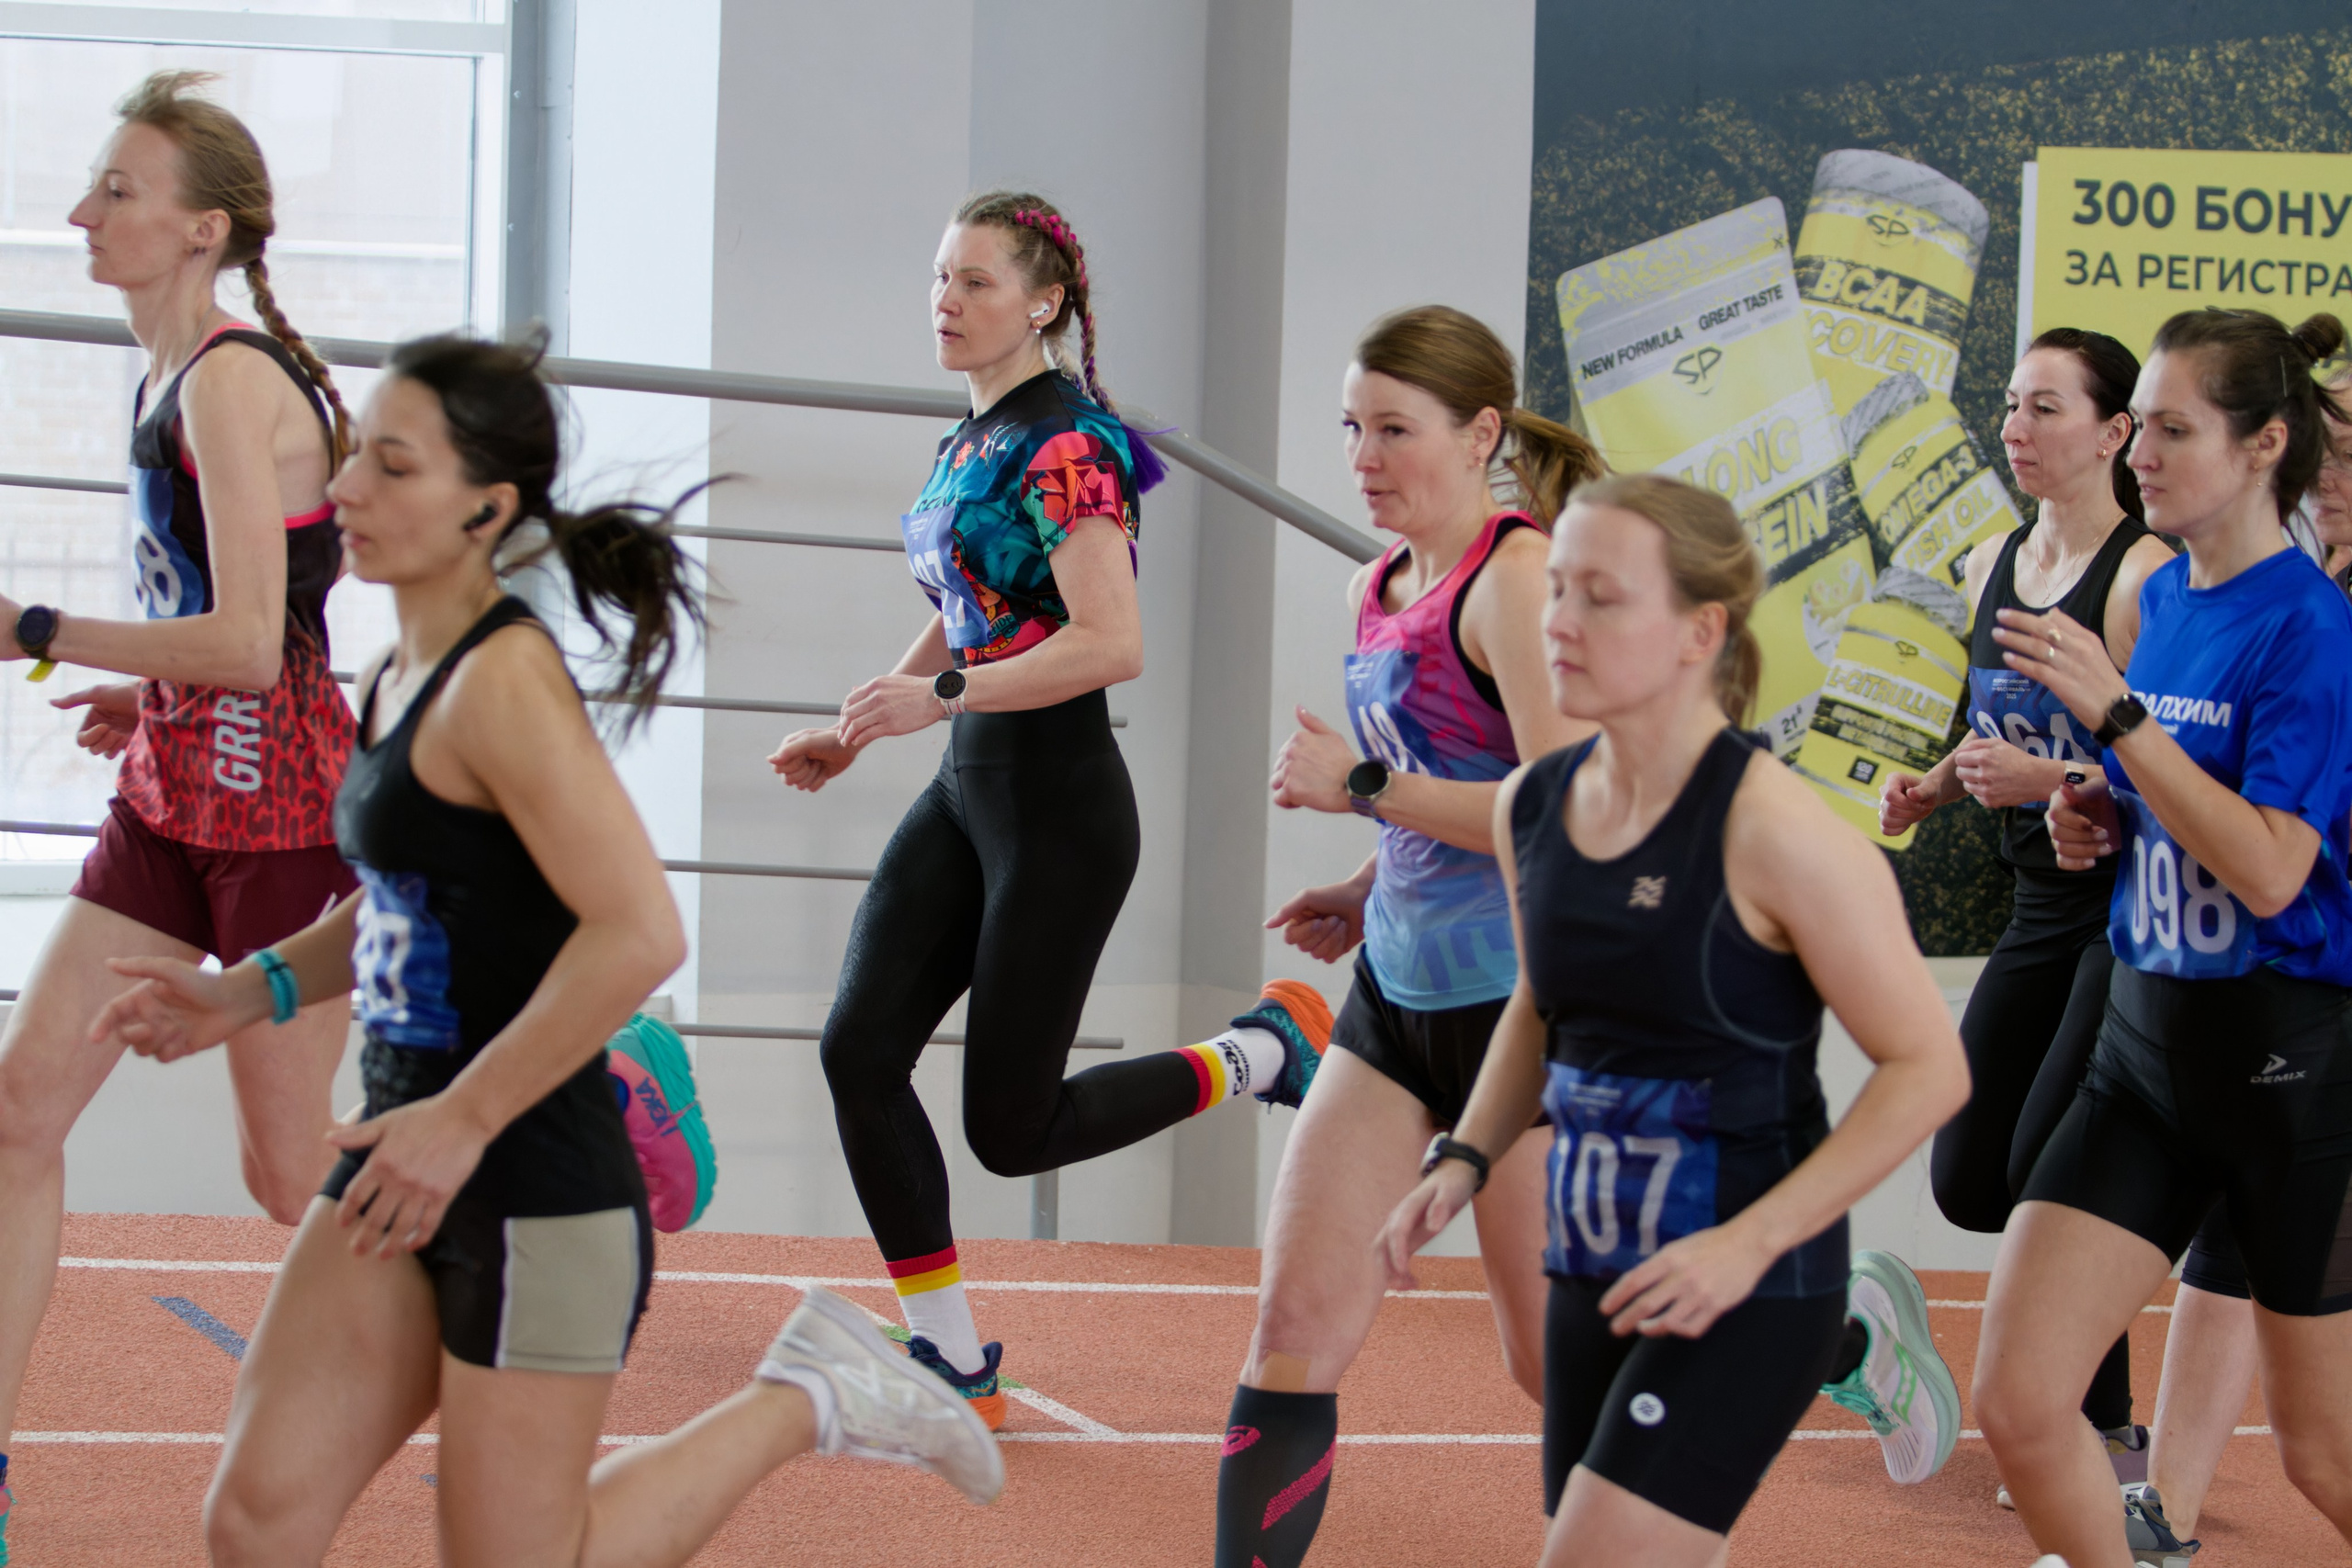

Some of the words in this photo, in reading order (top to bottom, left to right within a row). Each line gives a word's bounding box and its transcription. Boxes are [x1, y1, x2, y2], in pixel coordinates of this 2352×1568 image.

[2072, 179, 2176, 230] 300
[2196, 186, 2352, 238] БОНУ
[1812, 260, 1929, 326] BCAA
[2064, 249, 2121, 287] ЗА
[2138, 254, 2352, 298] РЕГИСТРА
[1581, 352, 1615, 379] NEW
[1618, 326, 1684, 365] FORMULA
[1699, 301, 1742, 331] GREAT
[1743, 284, 1784, 312] TASTE
[1804, 310, 1953, 385] COVERY
[1753, 479, 1829, 570] EIN
[1881, 445, 1977, 545] OMEGA-3
[1904, 513, 1953, 570] FISH
[1954, 485, 1994, 528] OIL
[1827, 665, 1953, 728] L-CITRULLINE
[213, 690, 262, 792] GRR
[2132, 834, 2236, 954] 098
[2250, 1070, 2307, 1084] DEMIX
[1554, 1131, 1682, 1258] 107
